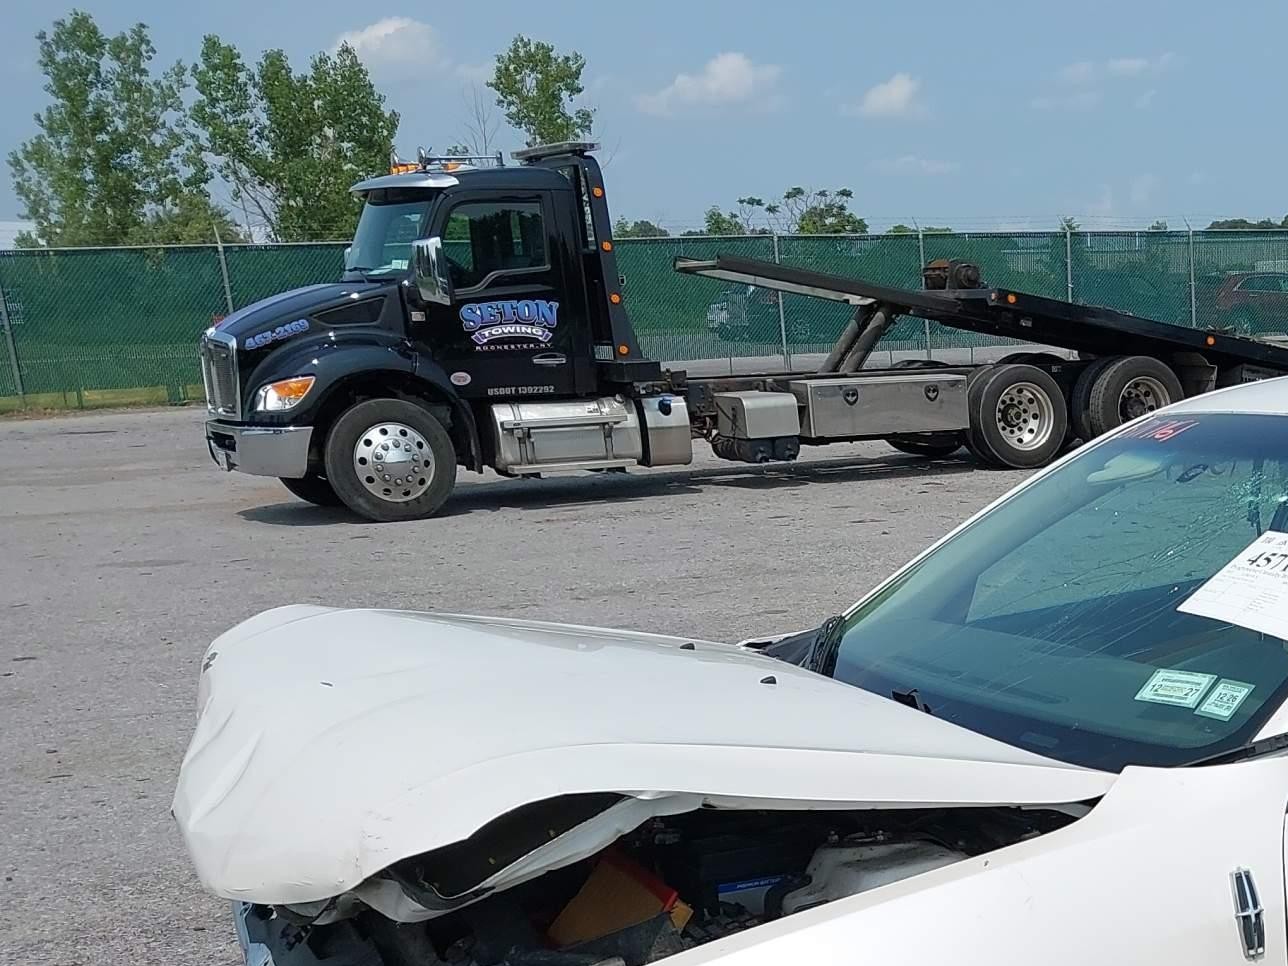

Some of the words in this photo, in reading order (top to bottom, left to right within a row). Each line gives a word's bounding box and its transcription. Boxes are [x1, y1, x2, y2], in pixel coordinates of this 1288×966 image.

[460, 300, 559, 331] SETON
[481, 326, 543, 337] TOWING
[487, 387, 516, 396] USDOT
[1149, 684, 1163, 692] 12
[1184, 688, 1201, 697] 27
[1216, 692, 1227, 701] 12
